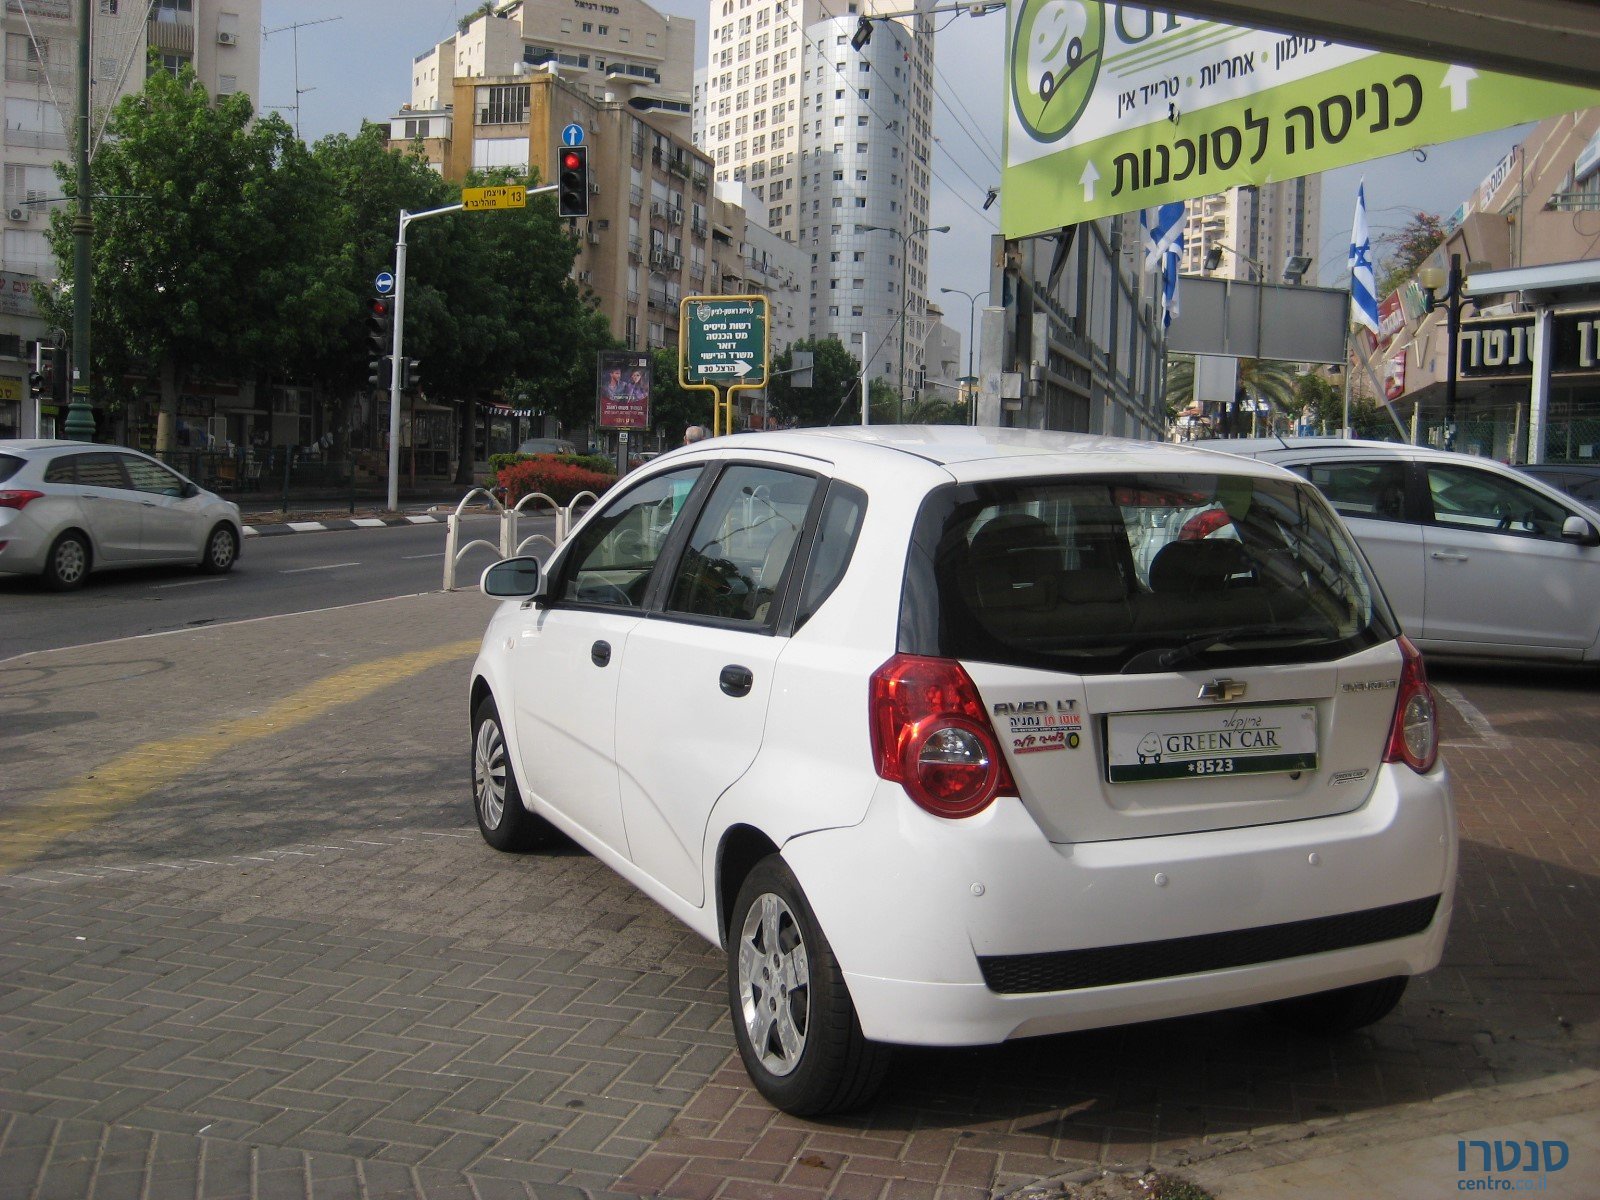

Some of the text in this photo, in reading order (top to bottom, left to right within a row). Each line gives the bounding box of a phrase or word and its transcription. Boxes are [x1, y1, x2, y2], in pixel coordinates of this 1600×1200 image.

[1200, 51, 1254, 90] אחריות
[1140, 75, 1180, 105] טרייד
[1117, 89, 1136, 119] אין
[1110, 73, 1423, 198] כניסה לסוכנות
[511, 191, 522, 202] 13
[703, 322, 751, 331] רשות מיסים
[706, 332, 733, 340] הכנסה
[717, 342, 737, 350] דואר
[729, 351, 754, 359] משרד
[993, 699, 1077, 716] AVEO LT
[1010, 716, 1041, 727] נתניה
[1166, 730, 1279, 752] GREEN CAR
